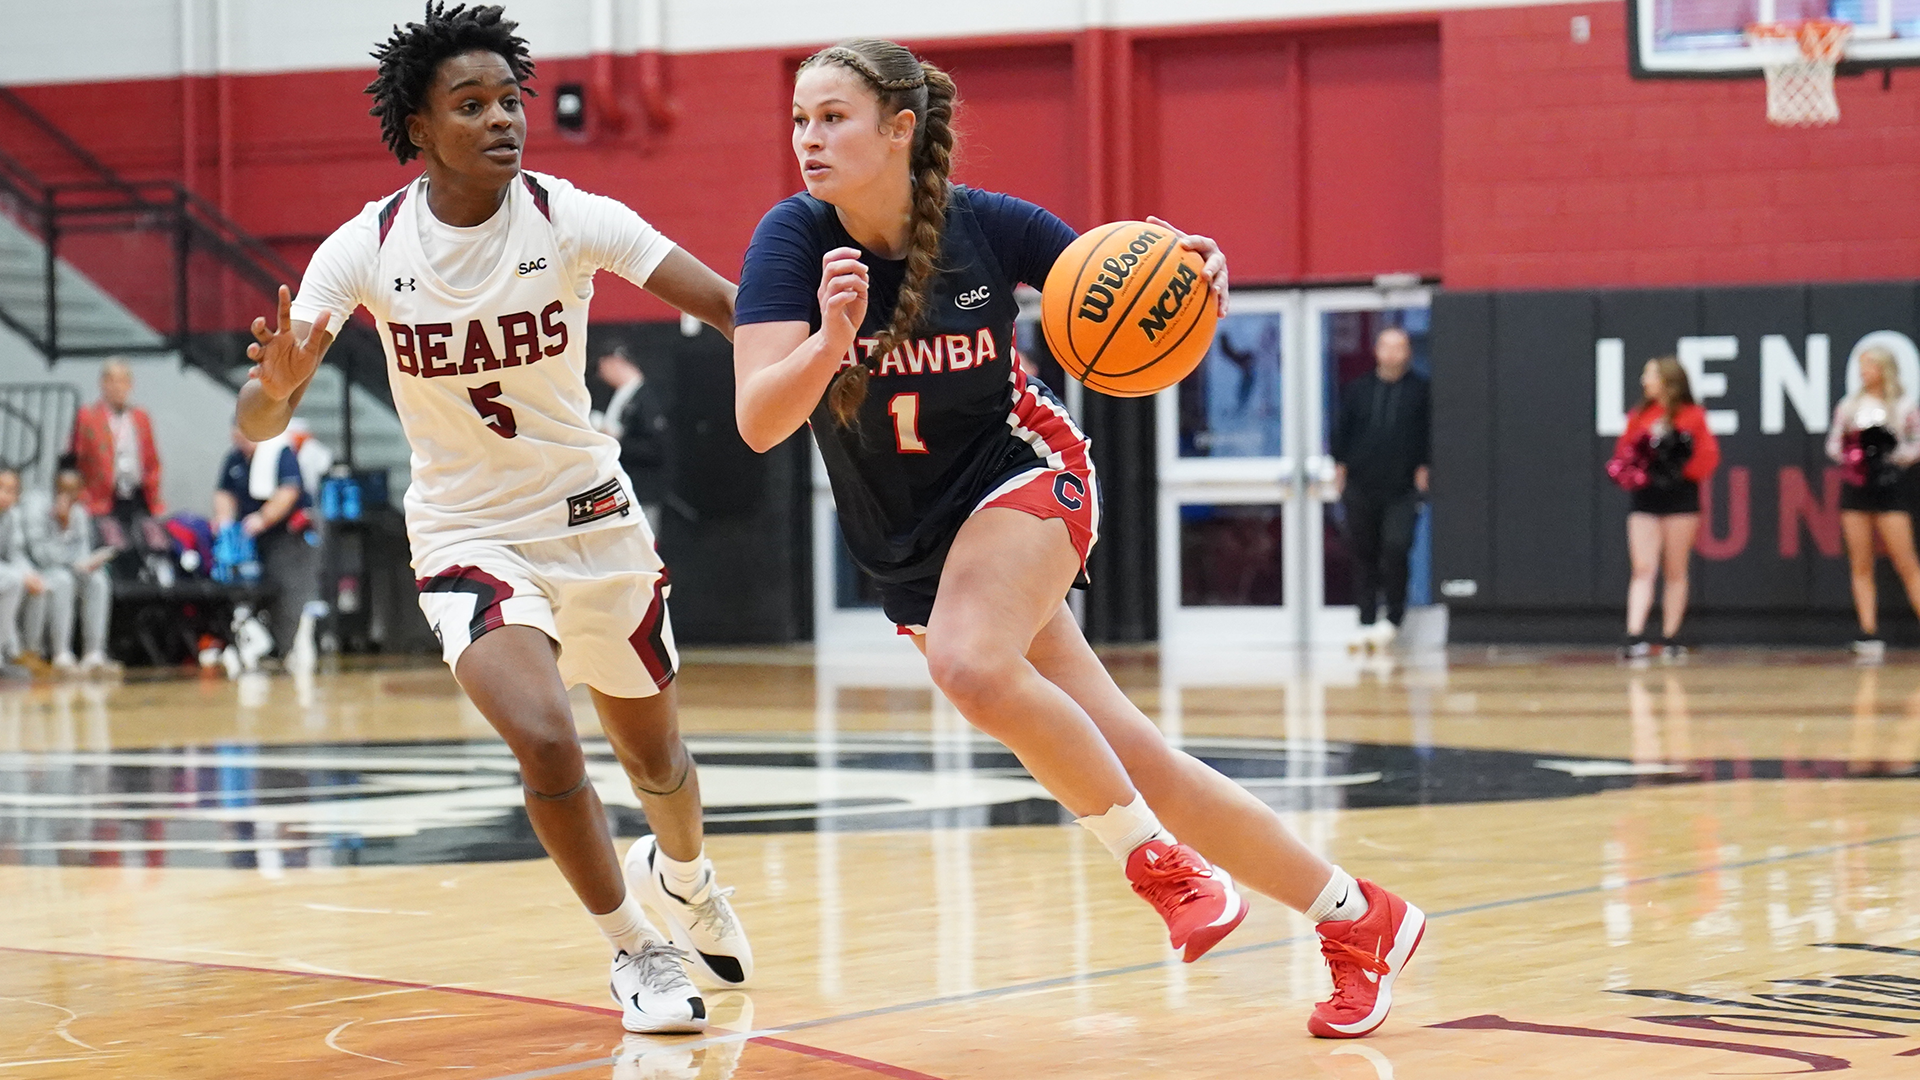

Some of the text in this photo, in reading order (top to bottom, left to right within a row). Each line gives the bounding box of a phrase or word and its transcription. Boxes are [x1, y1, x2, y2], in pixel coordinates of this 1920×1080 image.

[518, 257, 547, 275] SAC
[1077, 229, 1163, 324] Wilson
[959, 285, 991, 306] SAC
[1137, 262, 1199, 342] NCAA
[387, 299, 568, 379] BEARS
[836, 327, 998, 376] ATAWBA
[467, 381, 518, 439] 5
[888, 392, 930, 454] 1
[1052, 471, 1085, 511] C
